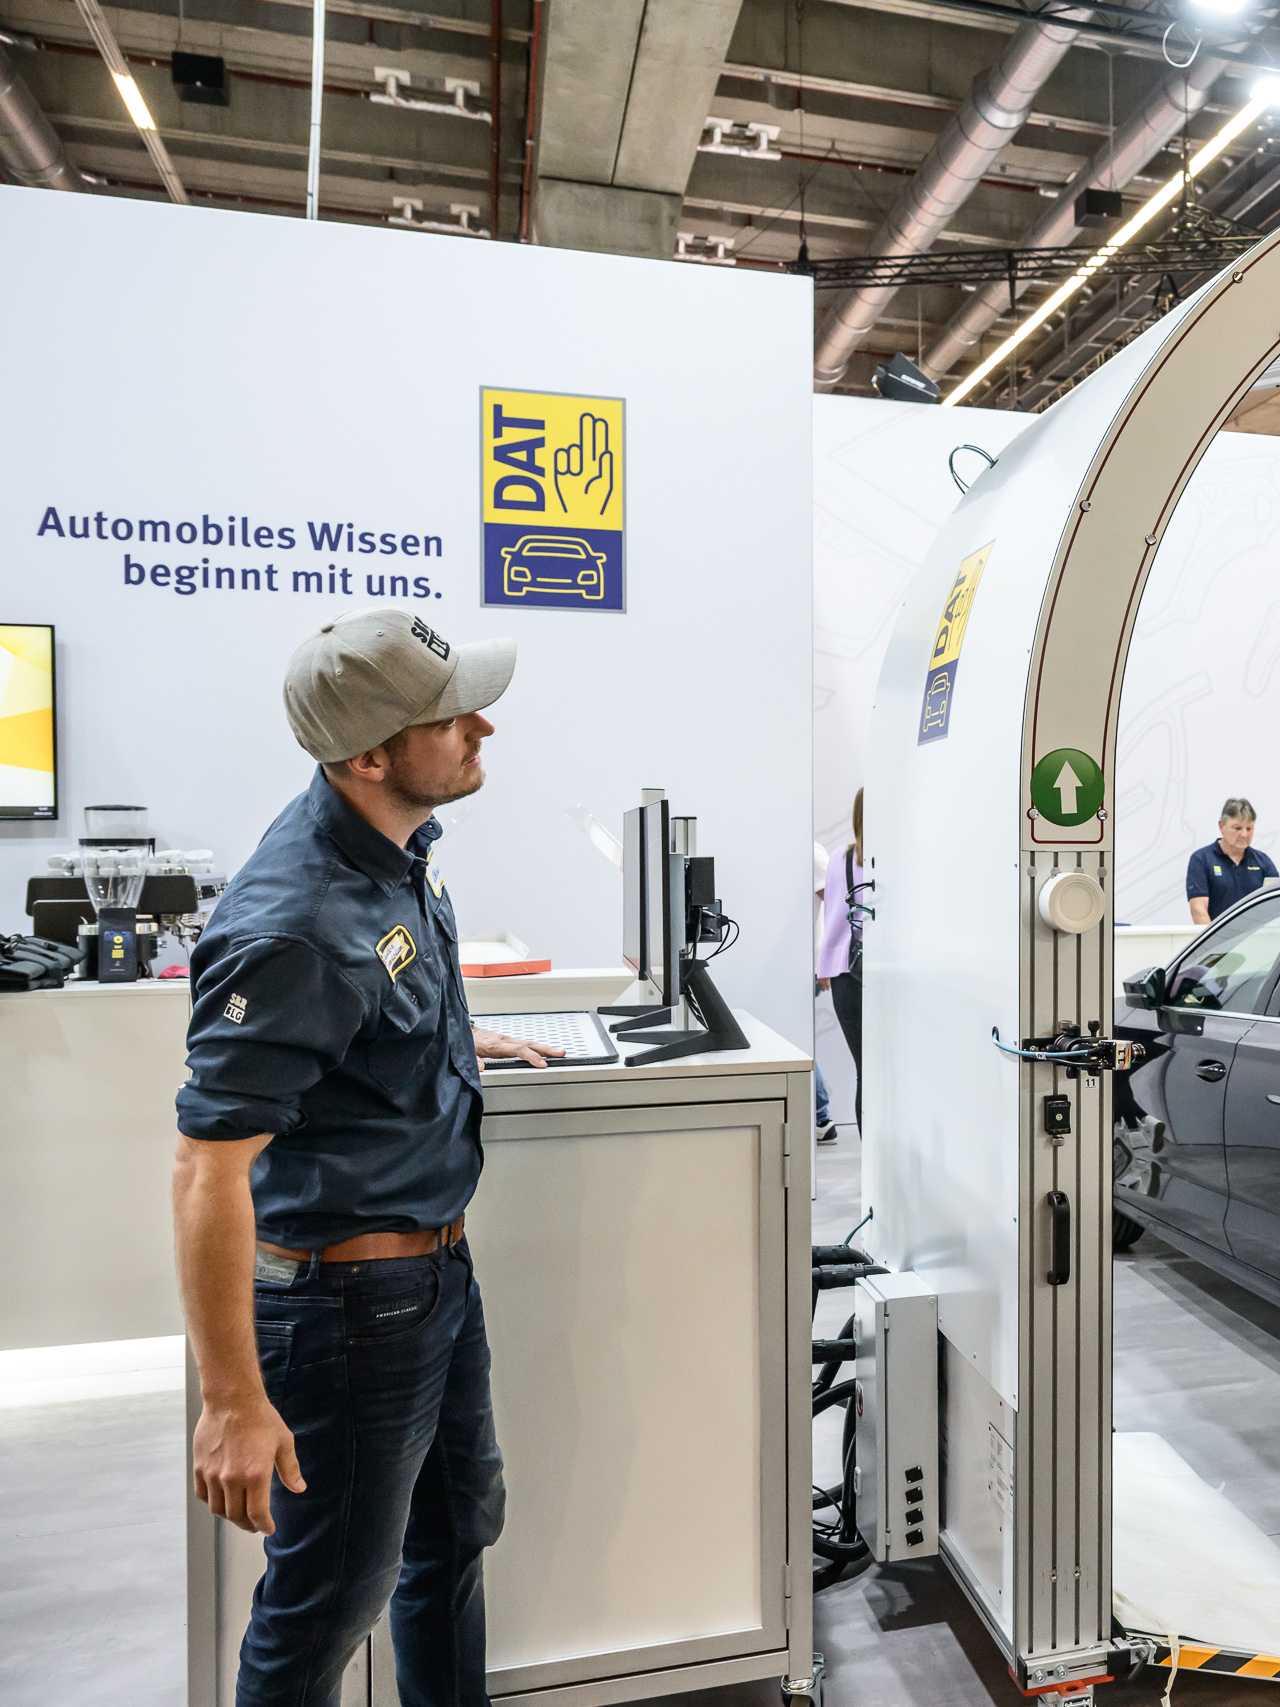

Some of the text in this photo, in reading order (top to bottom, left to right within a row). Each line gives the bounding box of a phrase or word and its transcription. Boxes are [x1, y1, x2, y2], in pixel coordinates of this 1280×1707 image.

[493, 403, 545, 512] DAT
[37, 506, 443, 557] Automobiles Wissen
[123, 553, 443, 600] beginnt mit uns.
[933, 570, 967, 659] DAT
[1085, 1079, 1096, 1087] 11
